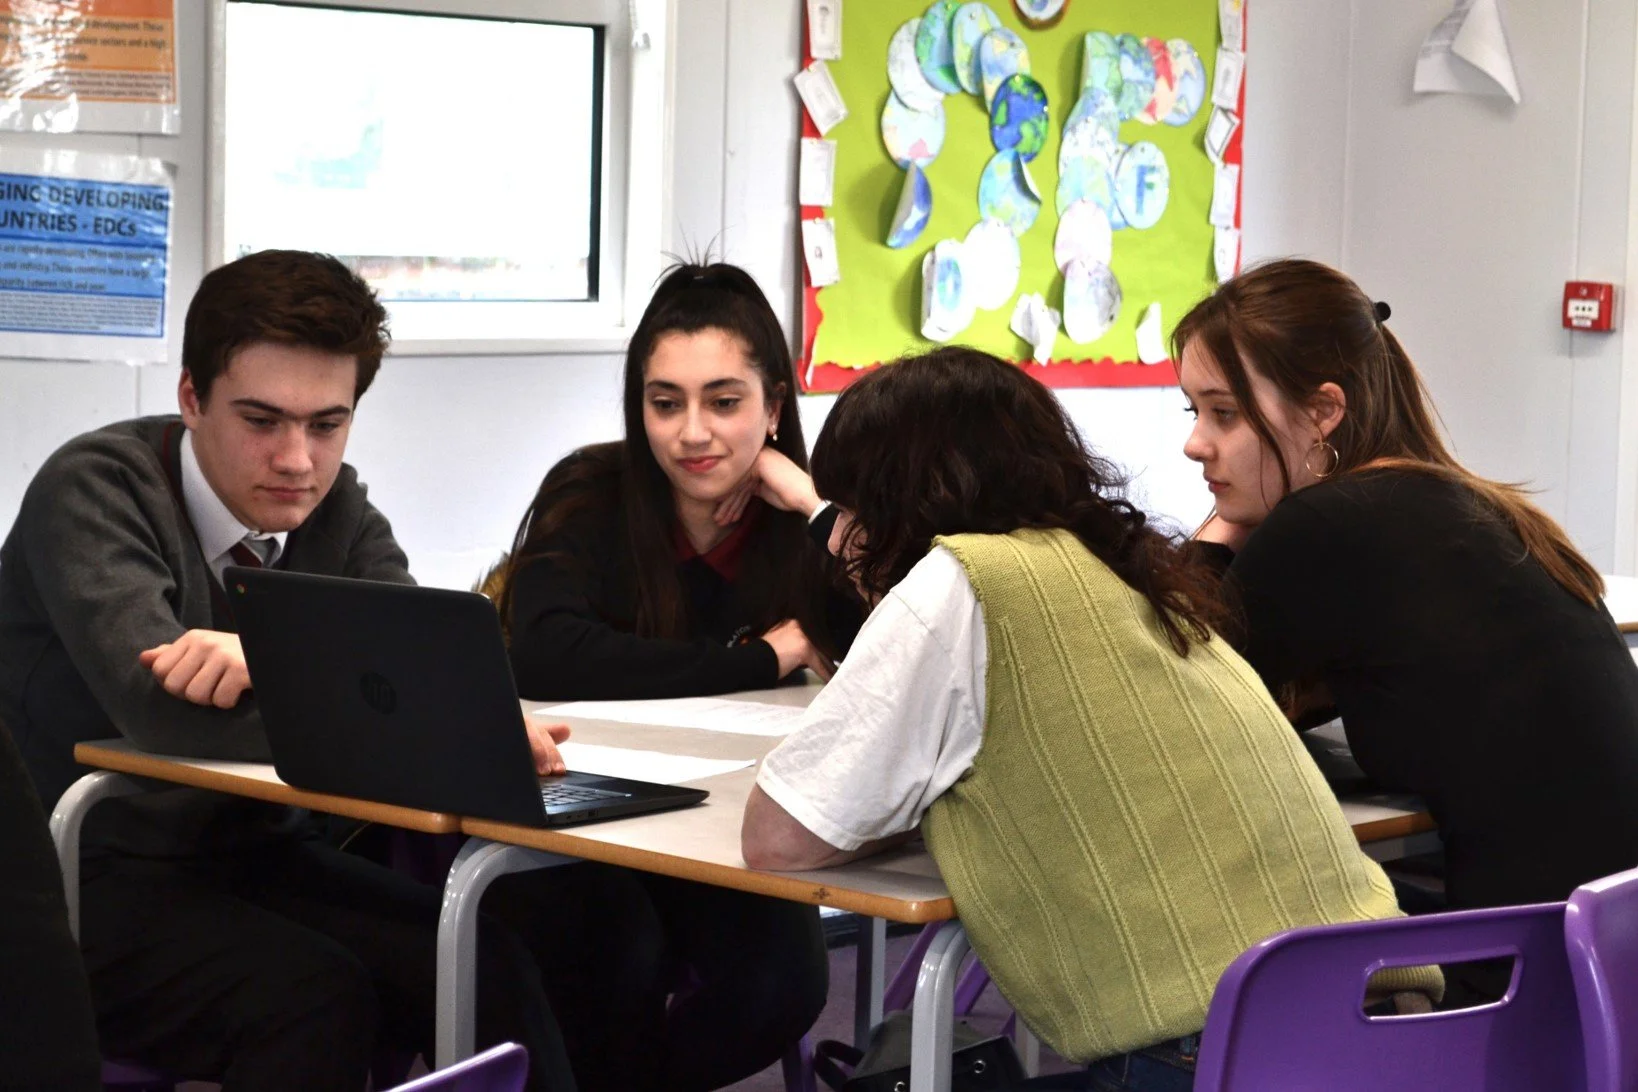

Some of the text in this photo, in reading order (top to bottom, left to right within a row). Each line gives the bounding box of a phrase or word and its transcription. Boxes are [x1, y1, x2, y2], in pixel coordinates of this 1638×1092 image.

[48, 185, 164, 212] DEVELOPING
[0, 209, 77, 233] UNTRIES
[94, 215, 136, 237] EDCs
